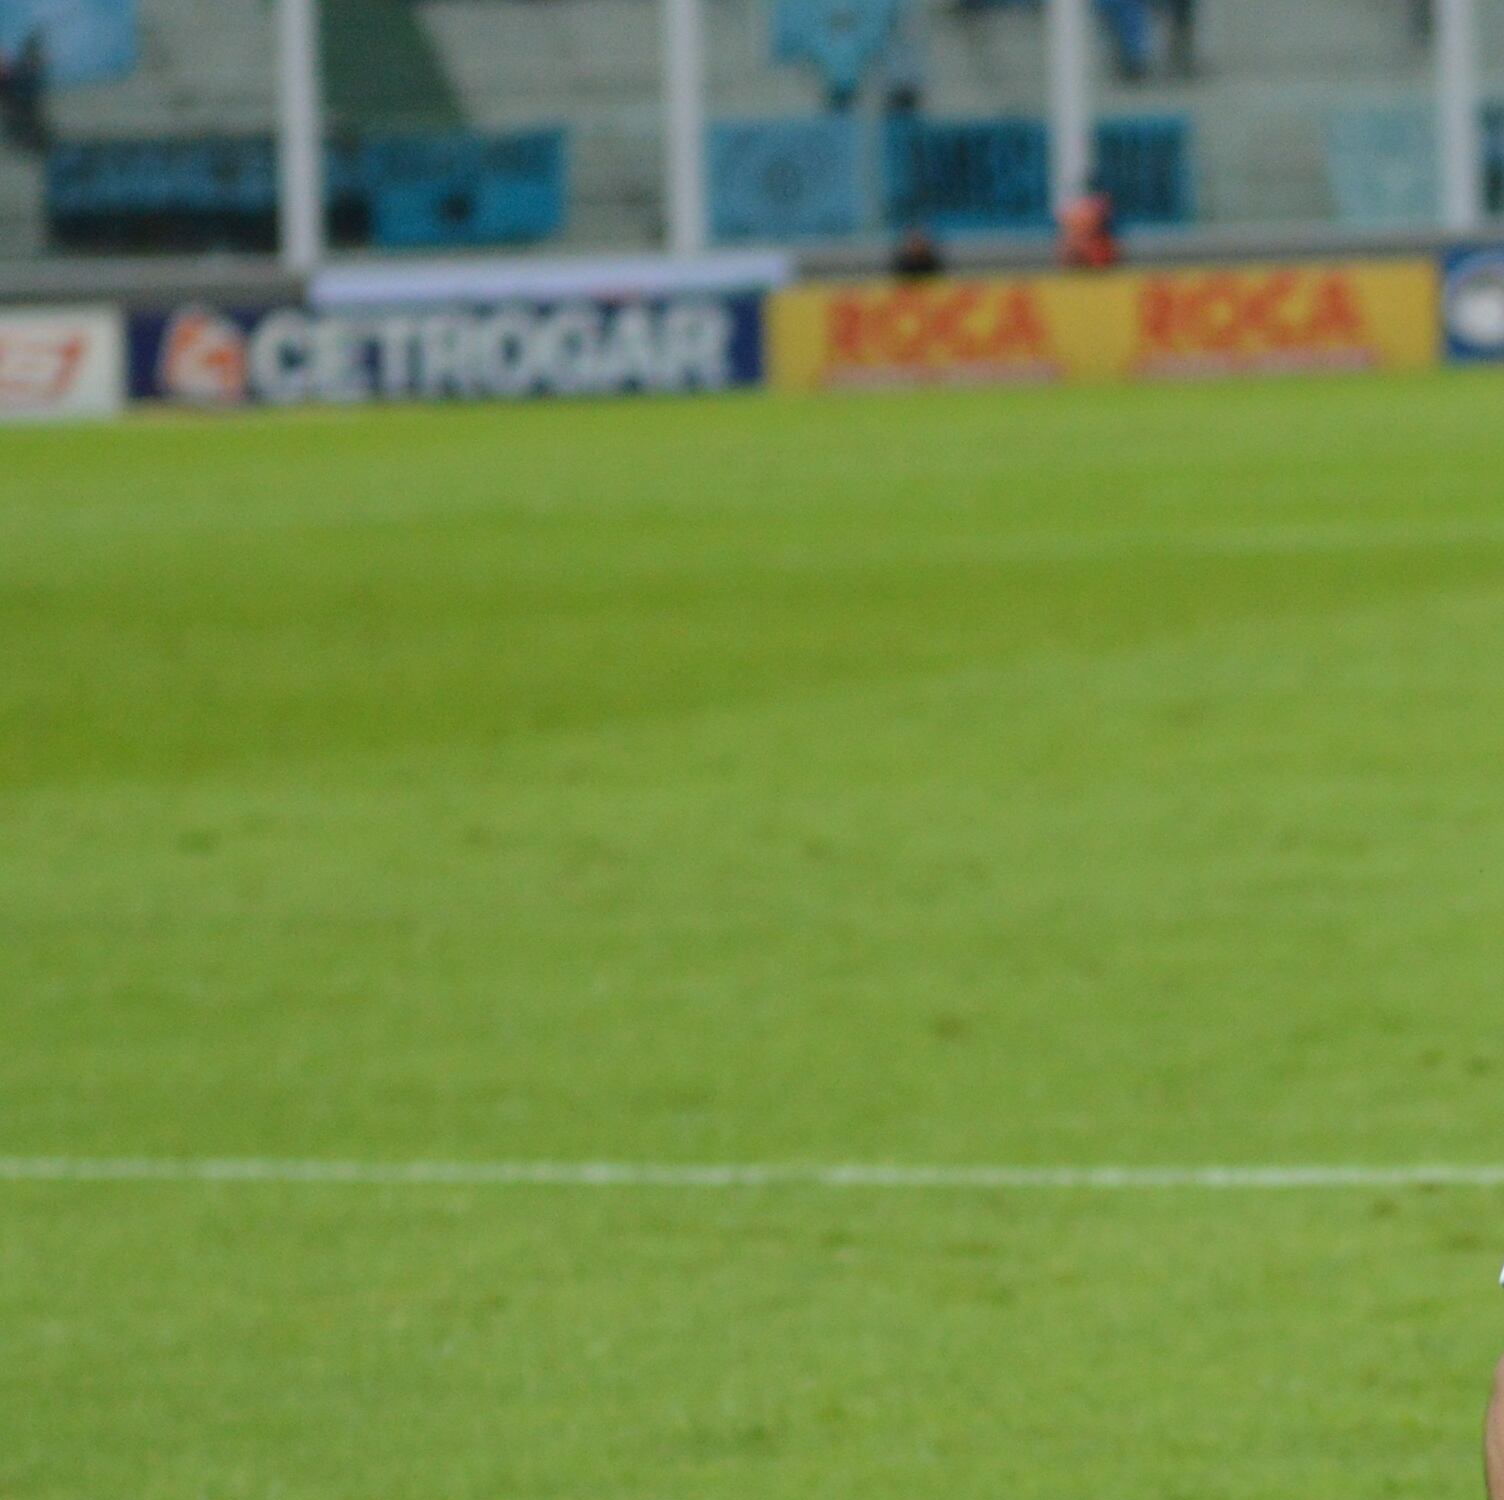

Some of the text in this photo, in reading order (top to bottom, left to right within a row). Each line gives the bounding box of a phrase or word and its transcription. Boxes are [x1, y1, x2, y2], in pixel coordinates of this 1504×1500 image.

[828, 283, 1052, 360] ROCA
[1138, 270, 1362, 347] ROCA
[249, 305, 727, 400] CETROGAR
